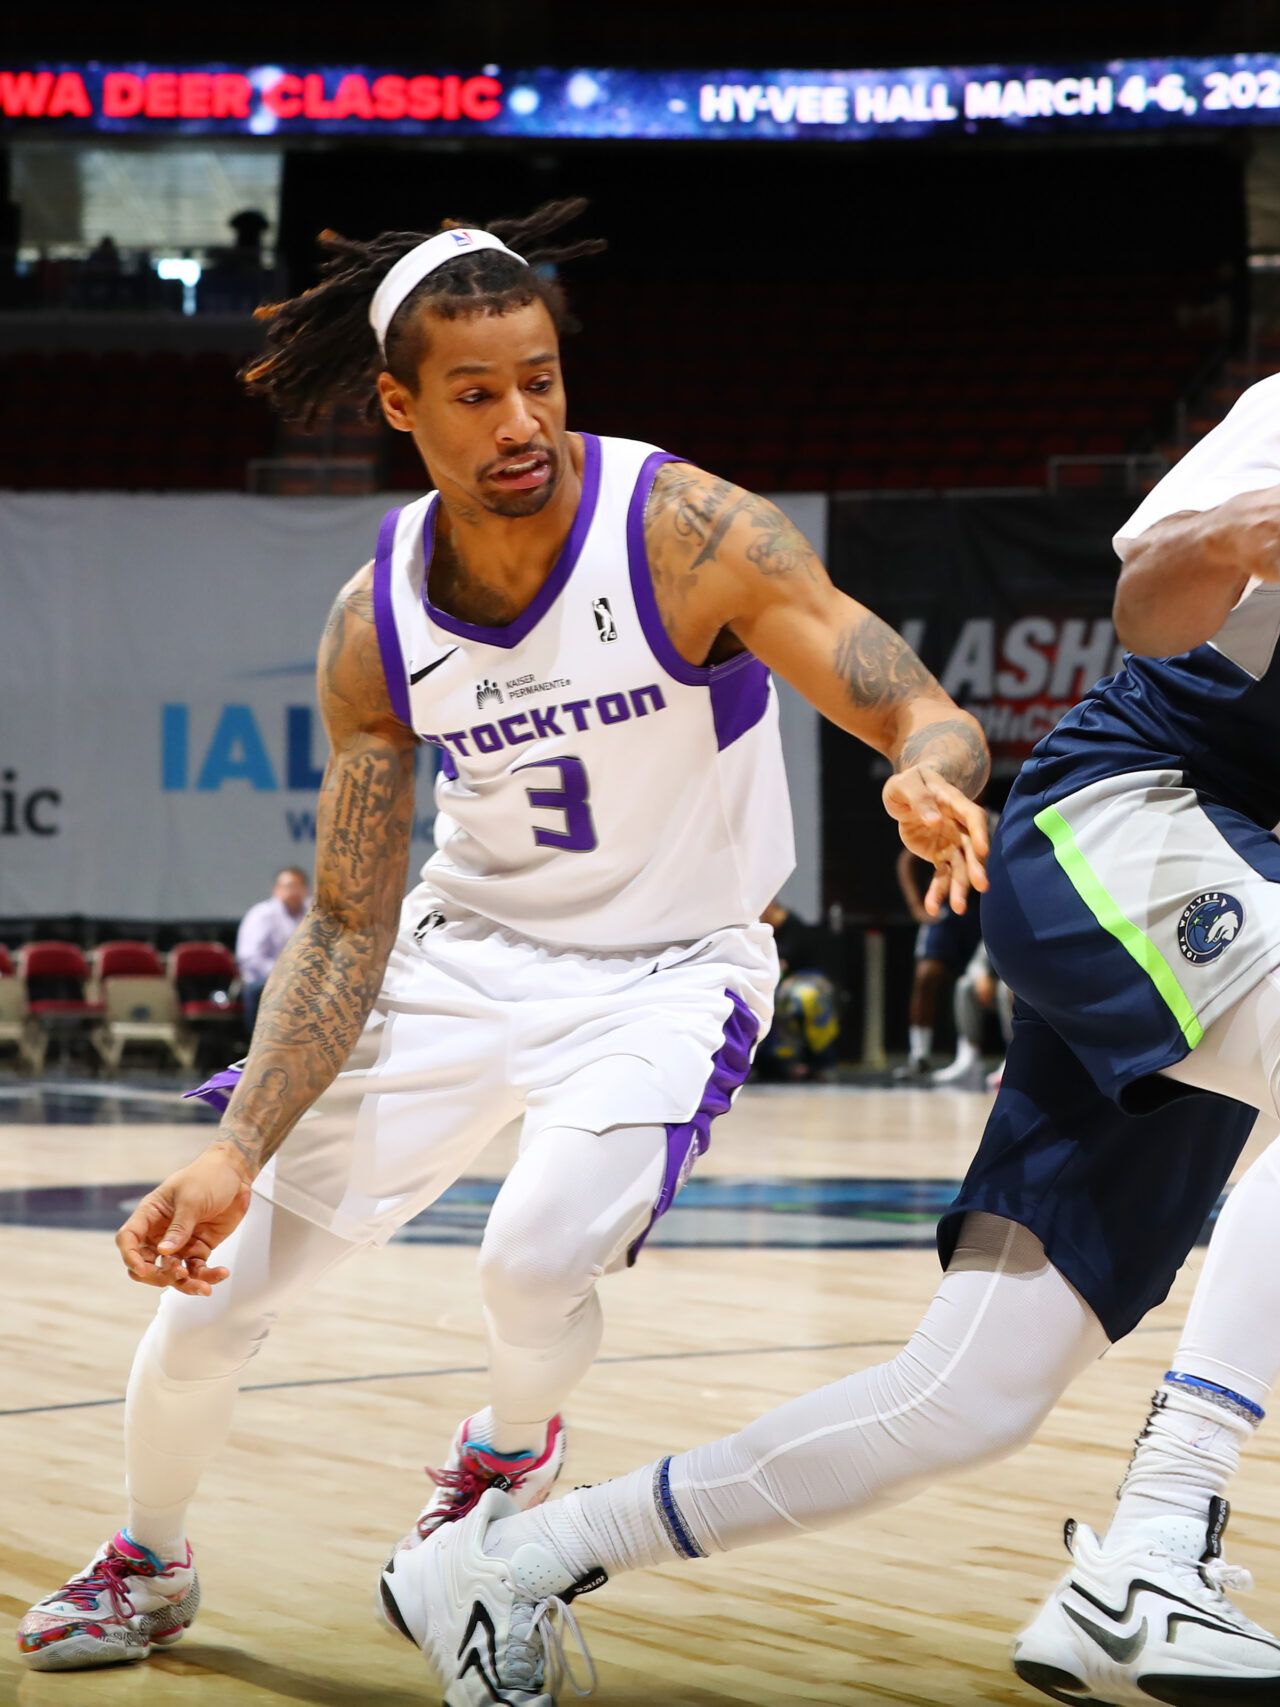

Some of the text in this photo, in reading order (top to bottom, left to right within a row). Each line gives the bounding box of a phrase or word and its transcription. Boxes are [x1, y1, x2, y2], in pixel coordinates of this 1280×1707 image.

[102, 73, 250, 118] DEER
[262, 75, 501, 120] CLASSIC
[700, 84, 849, 124] HY-VEE
[855, 84, 957, 123] HALL
[964, 77, 1114, 119] MARCH
[1118, 75, 1198, 116] 4-6,
[505, 673, 536, 689] KAISER
[511, 756, 599, 854] 3
[1179, 892, 1219, 962] IOWA WOLVES
